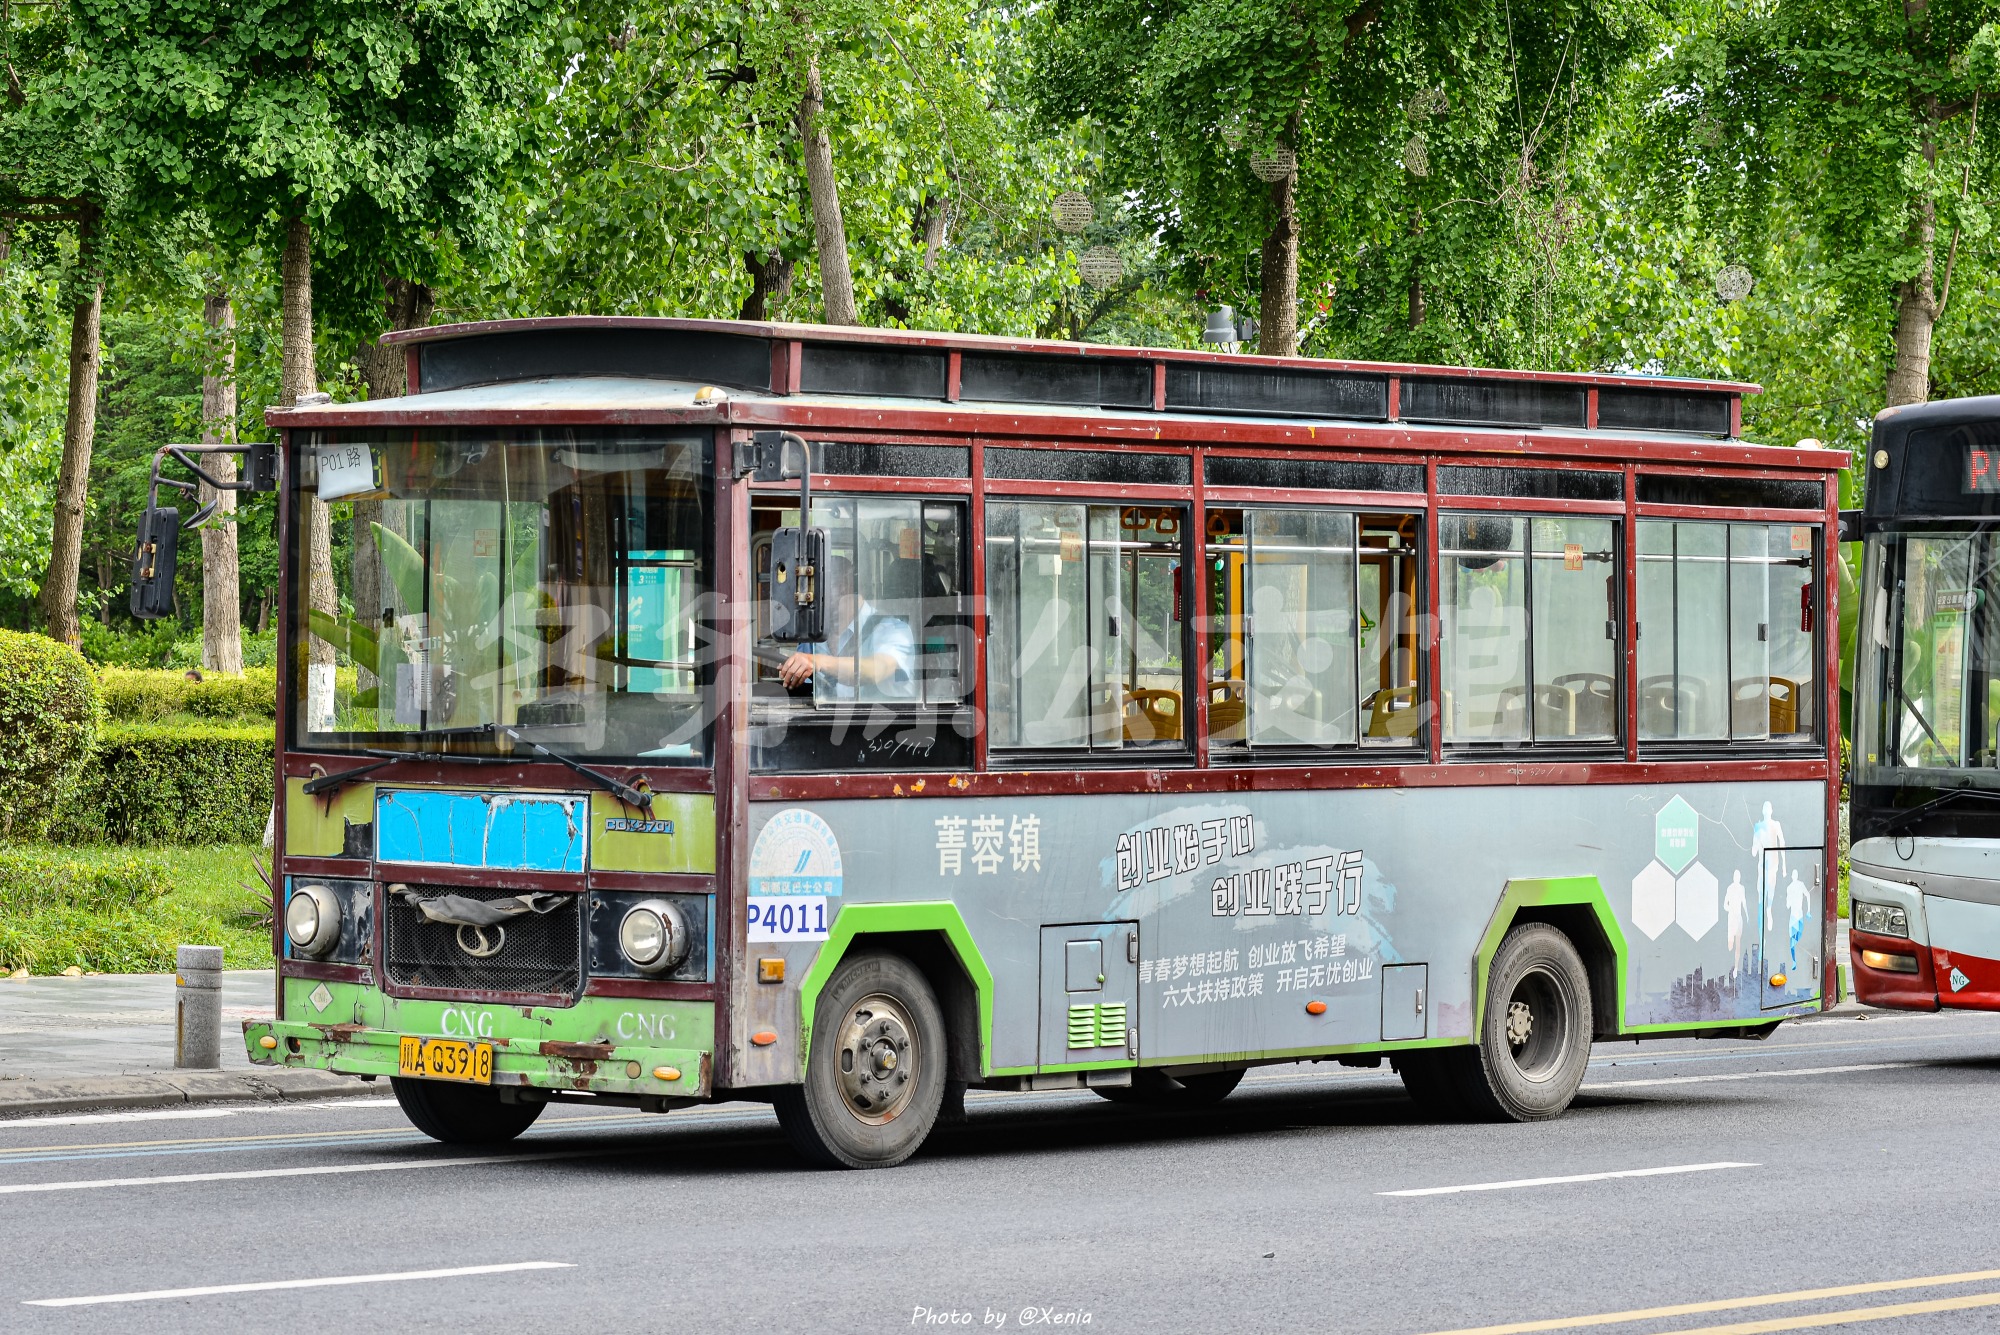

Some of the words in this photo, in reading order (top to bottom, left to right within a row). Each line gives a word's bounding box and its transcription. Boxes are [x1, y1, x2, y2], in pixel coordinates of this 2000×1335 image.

[1971, 450, 2000, 489] P
[934, 813, 1041, 876] 菁蓉镇
[1116, 814, 1255, 892] 创业始于心
[1211, 850, 1363, 916] 创业践于行
[747, 904, 827, 933] P4011
[842, 962, 879, 988] MICHELIN
[1140, 948, 1239, 984] 青春梦想起航
[1248, 934, 1346, 969] 创业放飞希望
[1163, 972, 1264, 1008] 六大扶持政策
[1277, 957, 1373, 993] 开启无忧创业
[441, 1008, 493, 1037] CNG
[617, 1012, 675, 1040] CNG
